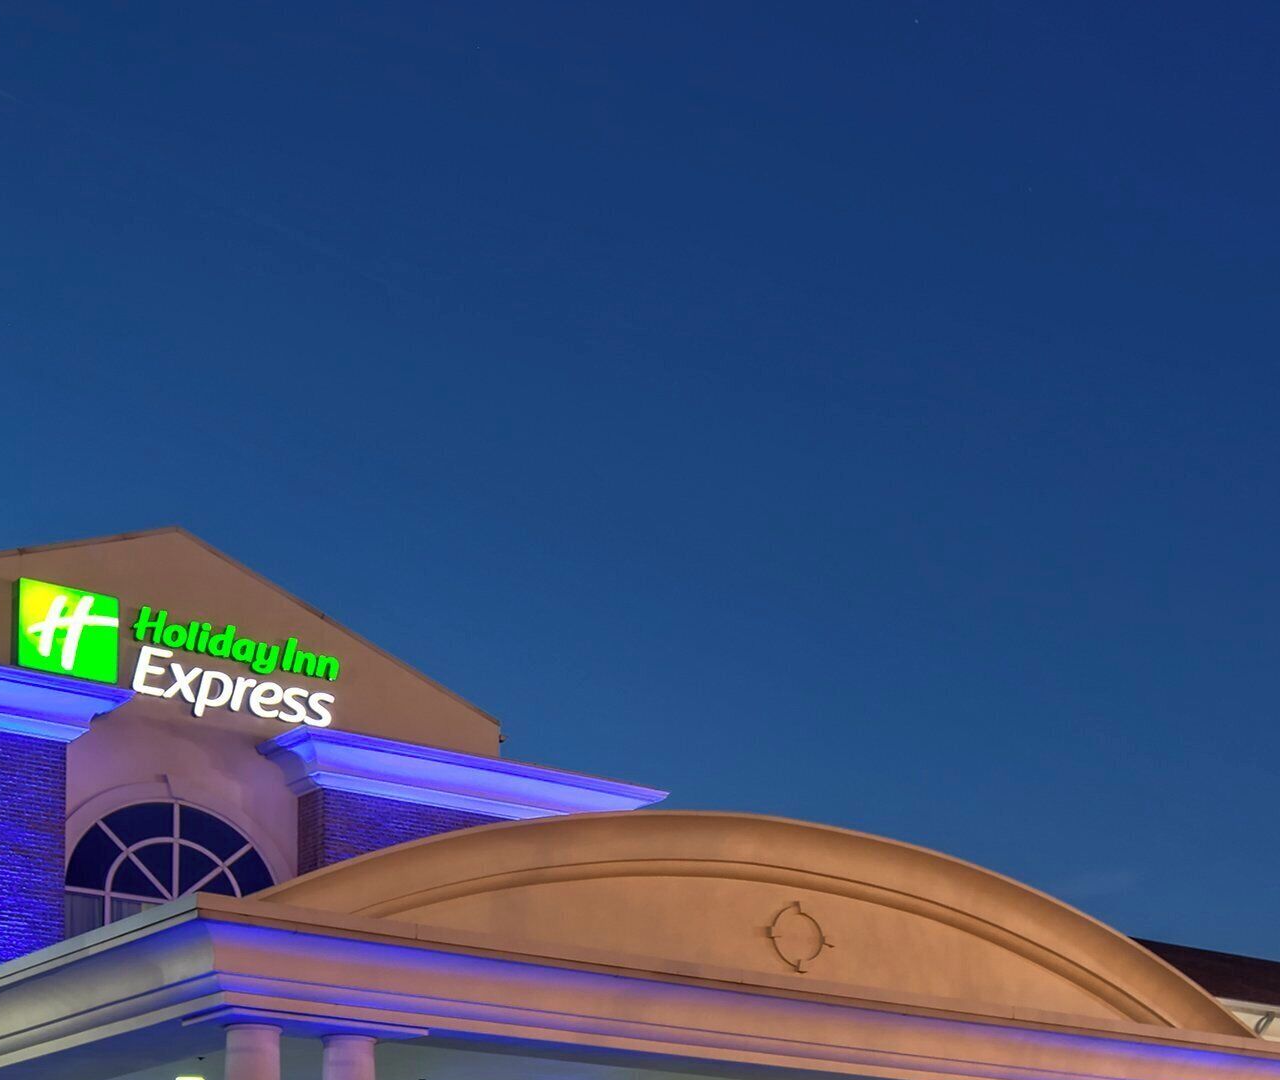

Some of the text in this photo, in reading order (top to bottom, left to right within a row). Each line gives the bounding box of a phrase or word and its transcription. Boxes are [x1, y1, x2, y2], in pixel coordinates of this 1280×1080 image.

[28, 595, 119, 671] H
[132, 605, 341, 682] Holiday Inn
[131, 645, 336, 728] Express
